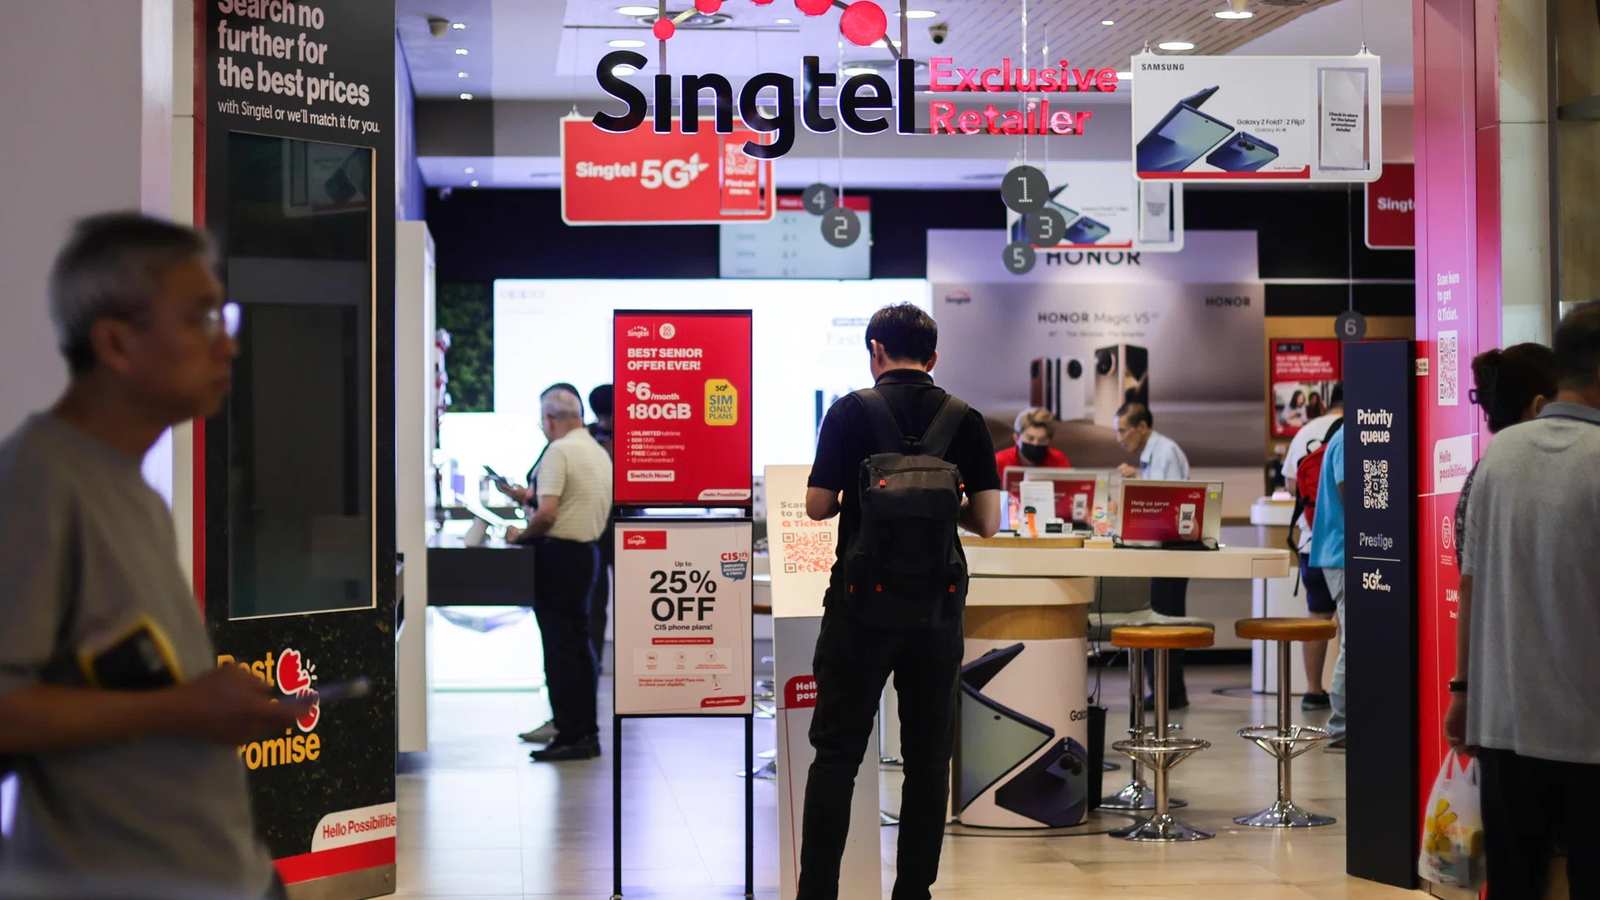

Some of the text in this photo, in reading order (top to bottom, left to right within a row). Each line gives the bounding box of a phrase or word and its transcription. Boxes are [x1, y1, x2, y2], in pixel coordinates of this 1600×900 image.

[218, 0, 325, 30] Search no
[218, 20, 328, 65] further for
[927, 57, 1119, 93] Exclusive
[1141, 63, 1184, 72] SAMSUNG
[218, 57, 370, 107] the best prices
[592, 50, 916, 160] Singtel
[218, 99, 381, 134] with Singtel or we'll match it for you.
[927, 100, 1093, 136] Retailer
[575, 161, 637, 181] Singtel
[1018, 176, 1032, 203] 1
[812, 190, 826, 209] 4
[1378, 198, 1415, 212] Singt
[834, 216, 848, 239] 2
[1039, 216, 1053, 239] 3
[1013, 248, 1026, 268] 5
[1046, 251, 1141, 266] HONOR
[1205, 296, 1250, 307] HONOR
[1038, 312, 1089, 324] HONOR
[1094, 312, 1130, 326] Magic
[1344, 319, 1357, 336] 6
[627, 348, 703, 358] BEST SENIOR
[627, 361, 700, 370] OFFER EVER!
[709, 396, 733, 405] SIM
[627, 403, 691, 419] 180GB
[1357, 409, 1392, 428] Priority
[1360, 430, 1390, 446] queue
[1360, 532, 1393, 550] Prestige
[721, 552, 738, 561] CIS
[650, 570, 717, 594] 25%
[651, 597, 716, 621] OFF
[796, 682, 817, 691] Hell
[322, 822, 346, 839] Hello
